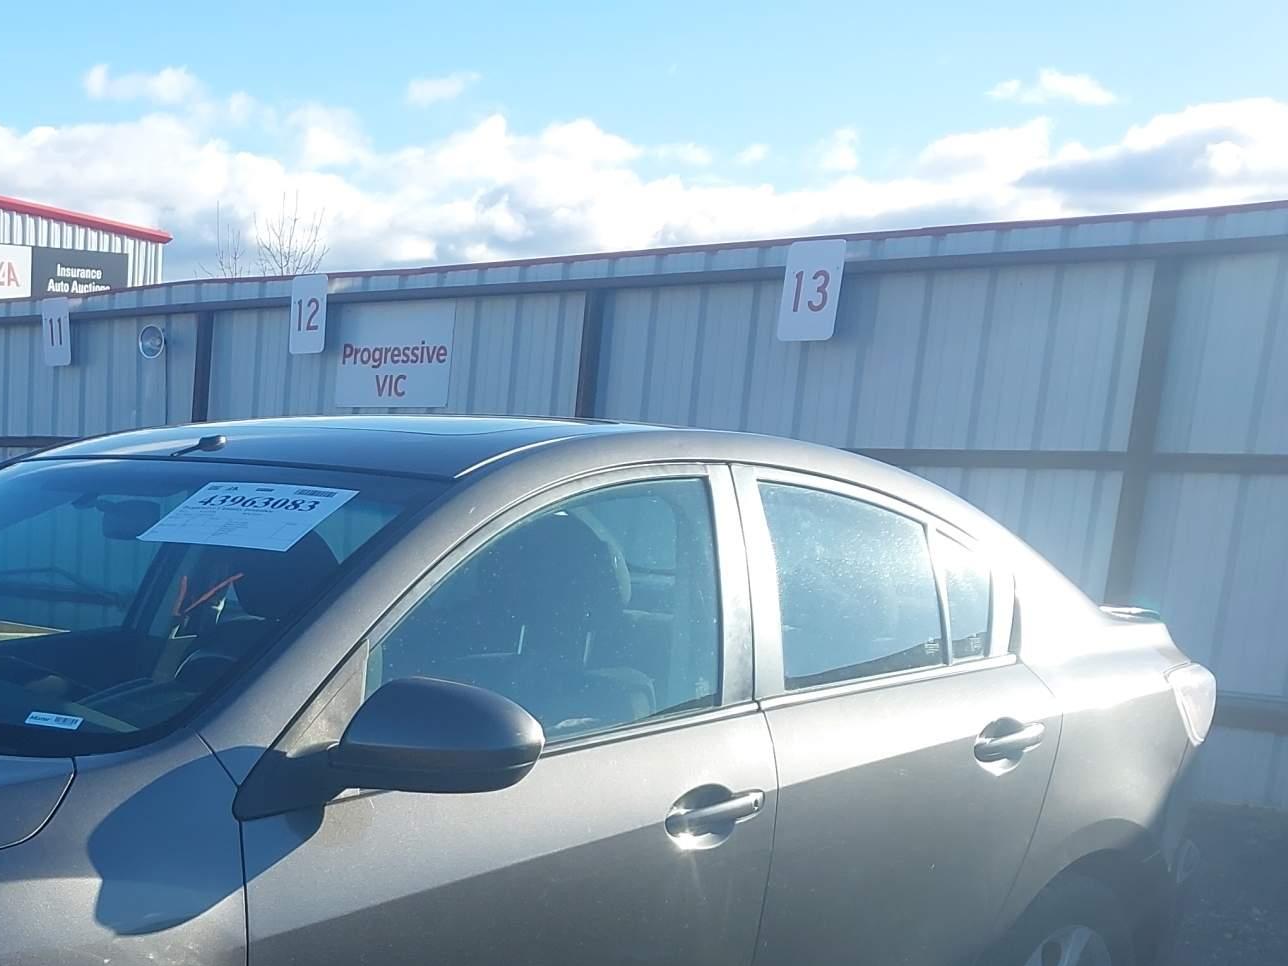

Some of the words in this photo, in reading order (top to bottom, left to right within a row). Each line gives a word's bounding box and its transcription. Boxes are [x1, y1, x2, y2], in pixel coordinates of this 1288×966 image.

[56, 263, 103, 280] Insurance
[47, 278, 70, 293] Auto
[792, 269, 831, 313] 13
[297, 297, 320, 332] 12
[48, 317, 63, 347] 11
[341, 340, 448, 369] Progressive
[375, 374, 407, 397] VIC
[198, 494, 321, 512] 43963083
